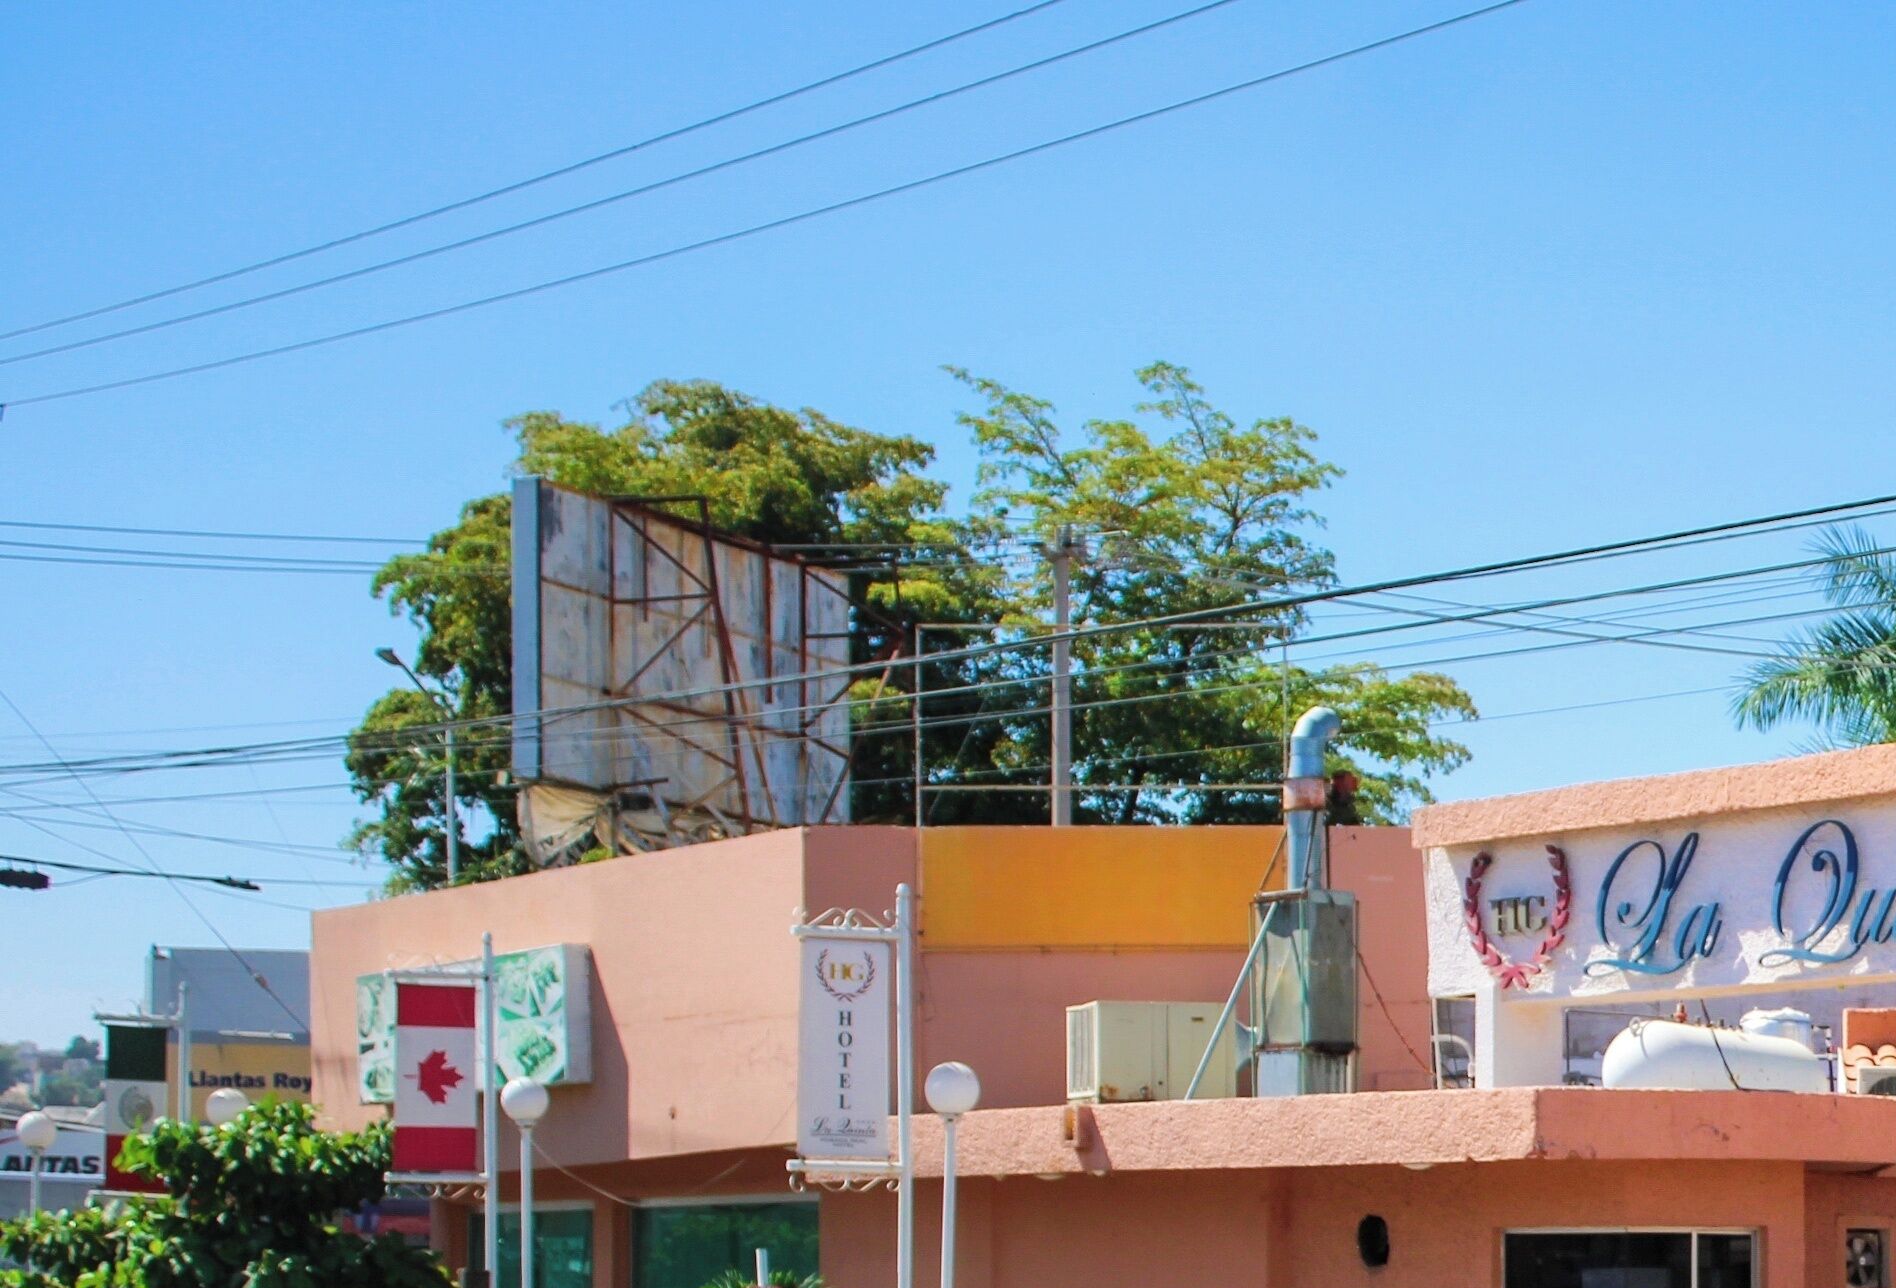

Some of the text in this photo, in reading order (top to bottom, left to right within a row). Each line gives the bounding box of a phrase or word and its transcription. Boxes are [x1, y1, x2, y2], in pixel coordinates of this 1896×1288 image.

[1584, 832, 1722, 977] La
[188, 1070, 266, 1089] Llantas
[838, 1011, 853, 1110] HOTEL
